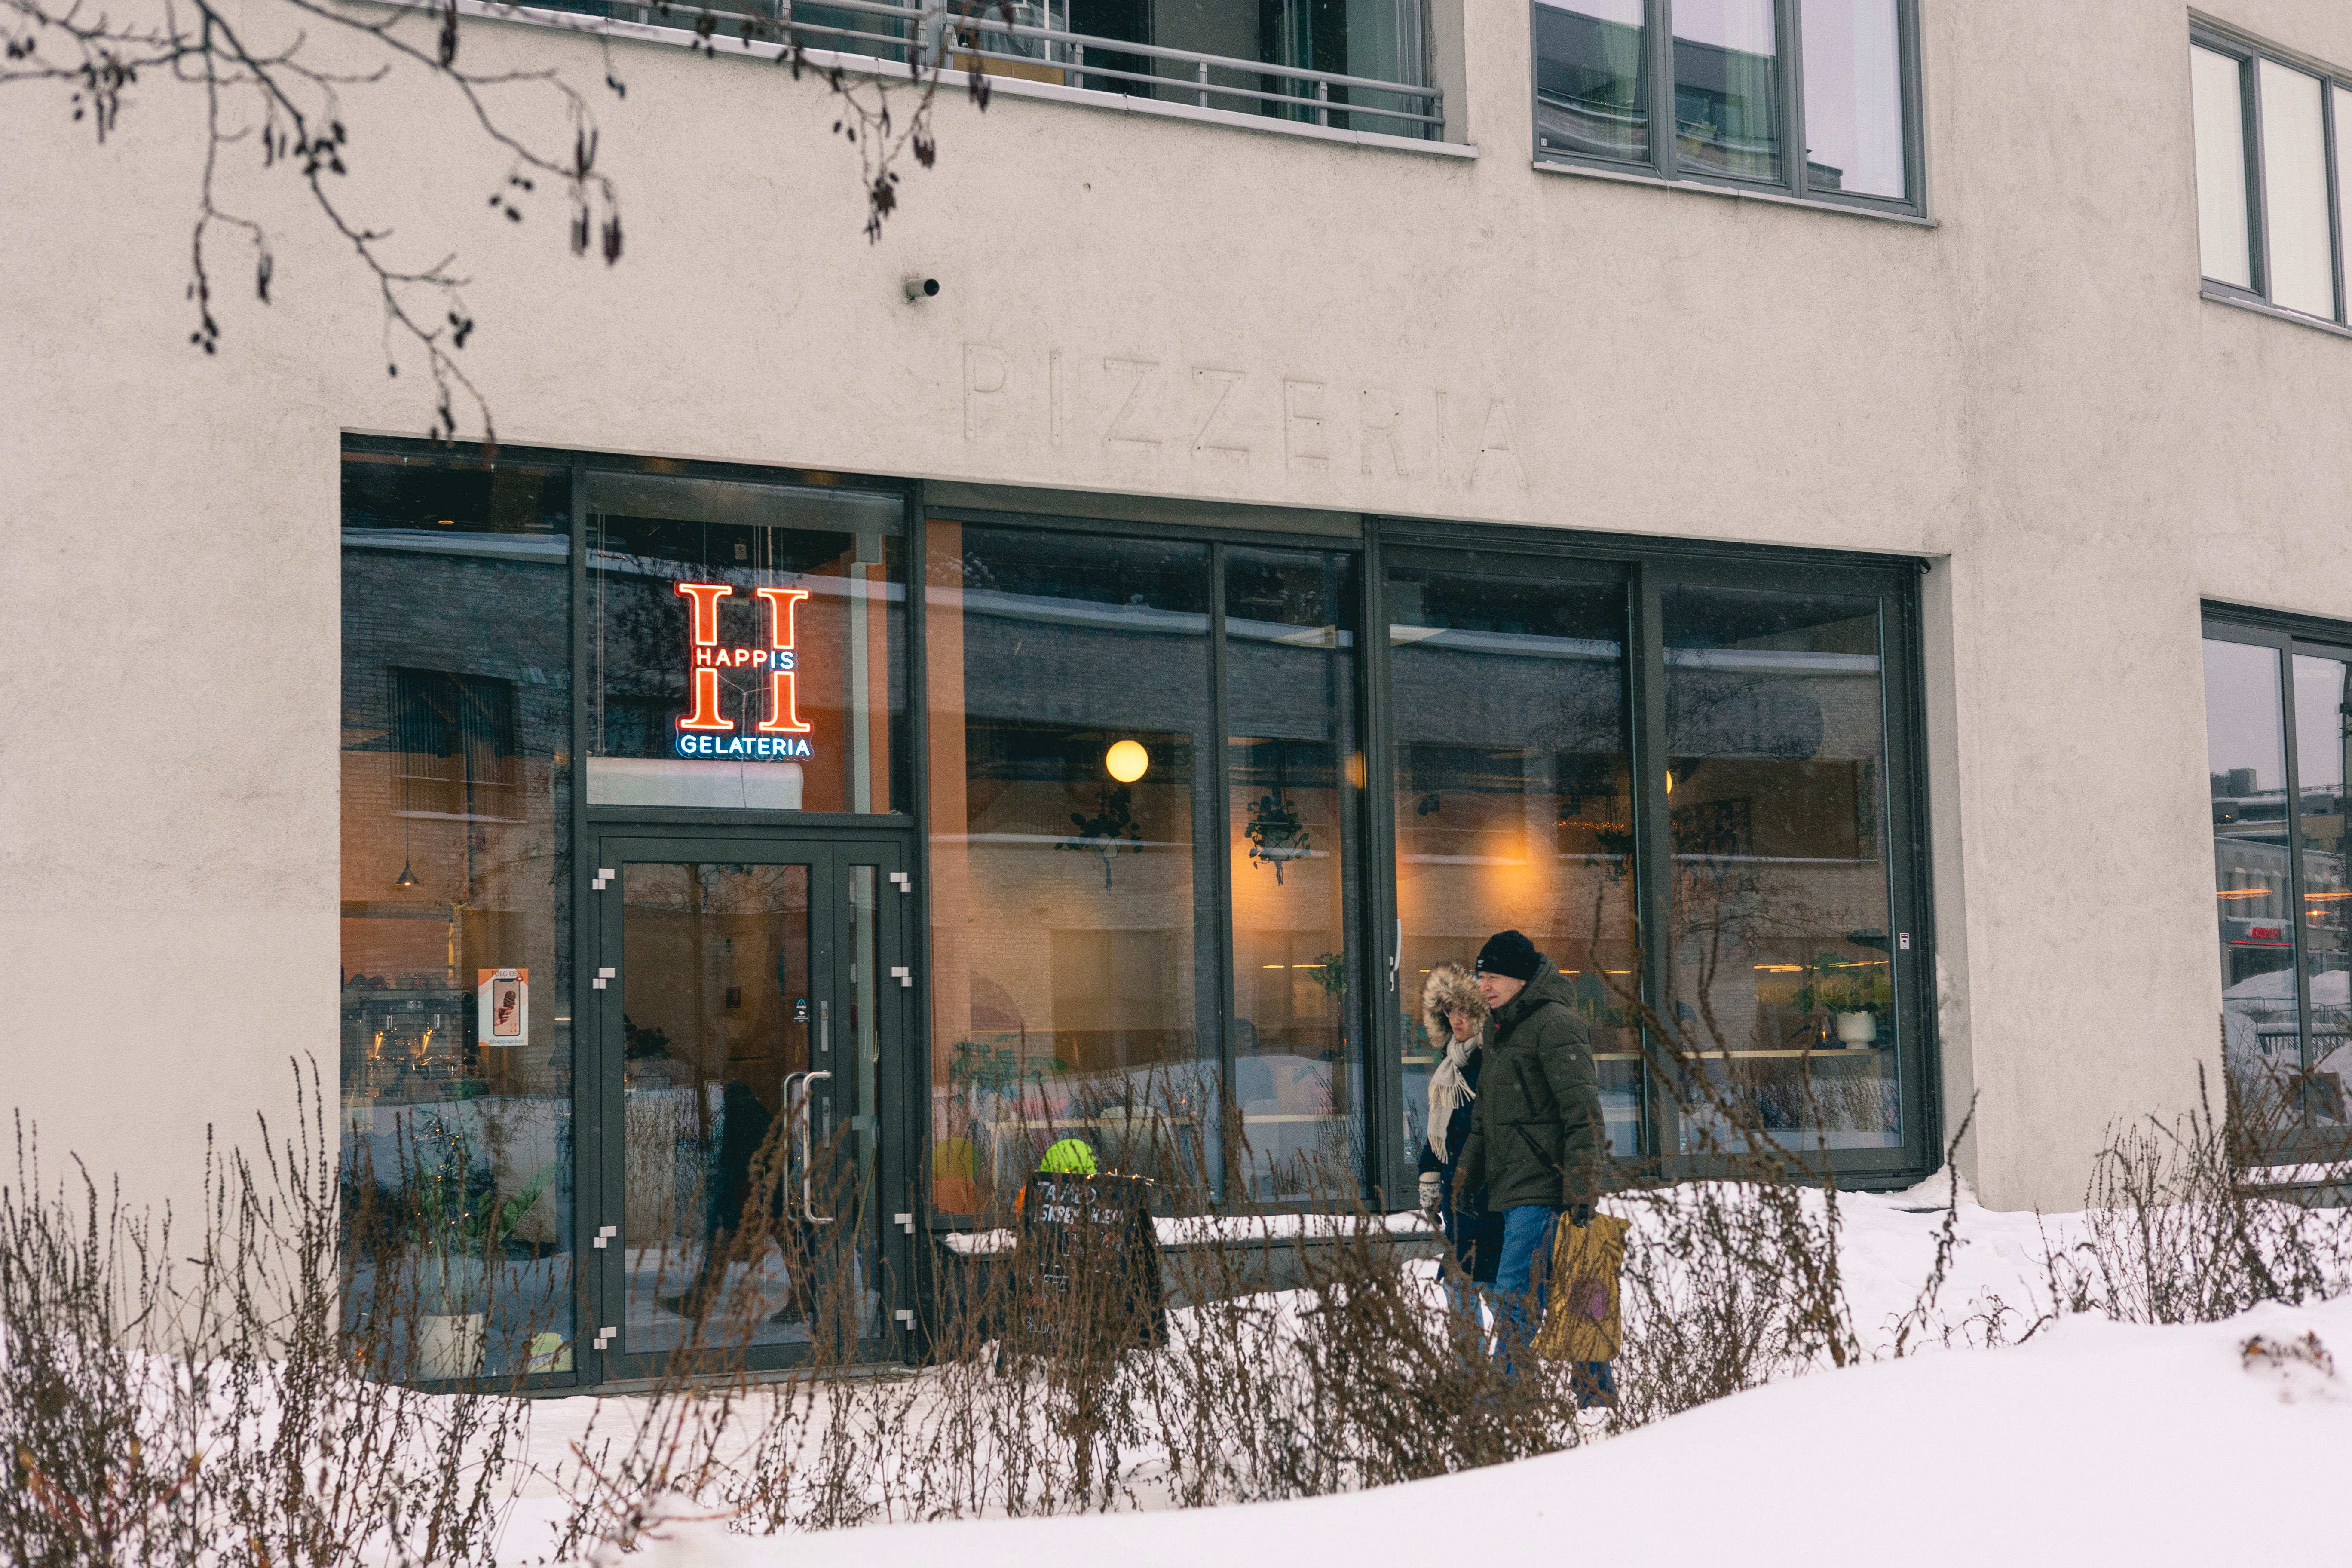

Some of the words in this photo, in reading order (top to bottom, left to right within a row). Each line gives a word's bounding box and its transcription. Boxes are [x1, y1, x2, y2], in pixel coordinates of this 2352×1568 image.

[963, 342, 1530, 490] PIZZERIA
[696, 647, 795, 670] HAPPIS
[680, 735, 811, 756] GELATERIA
